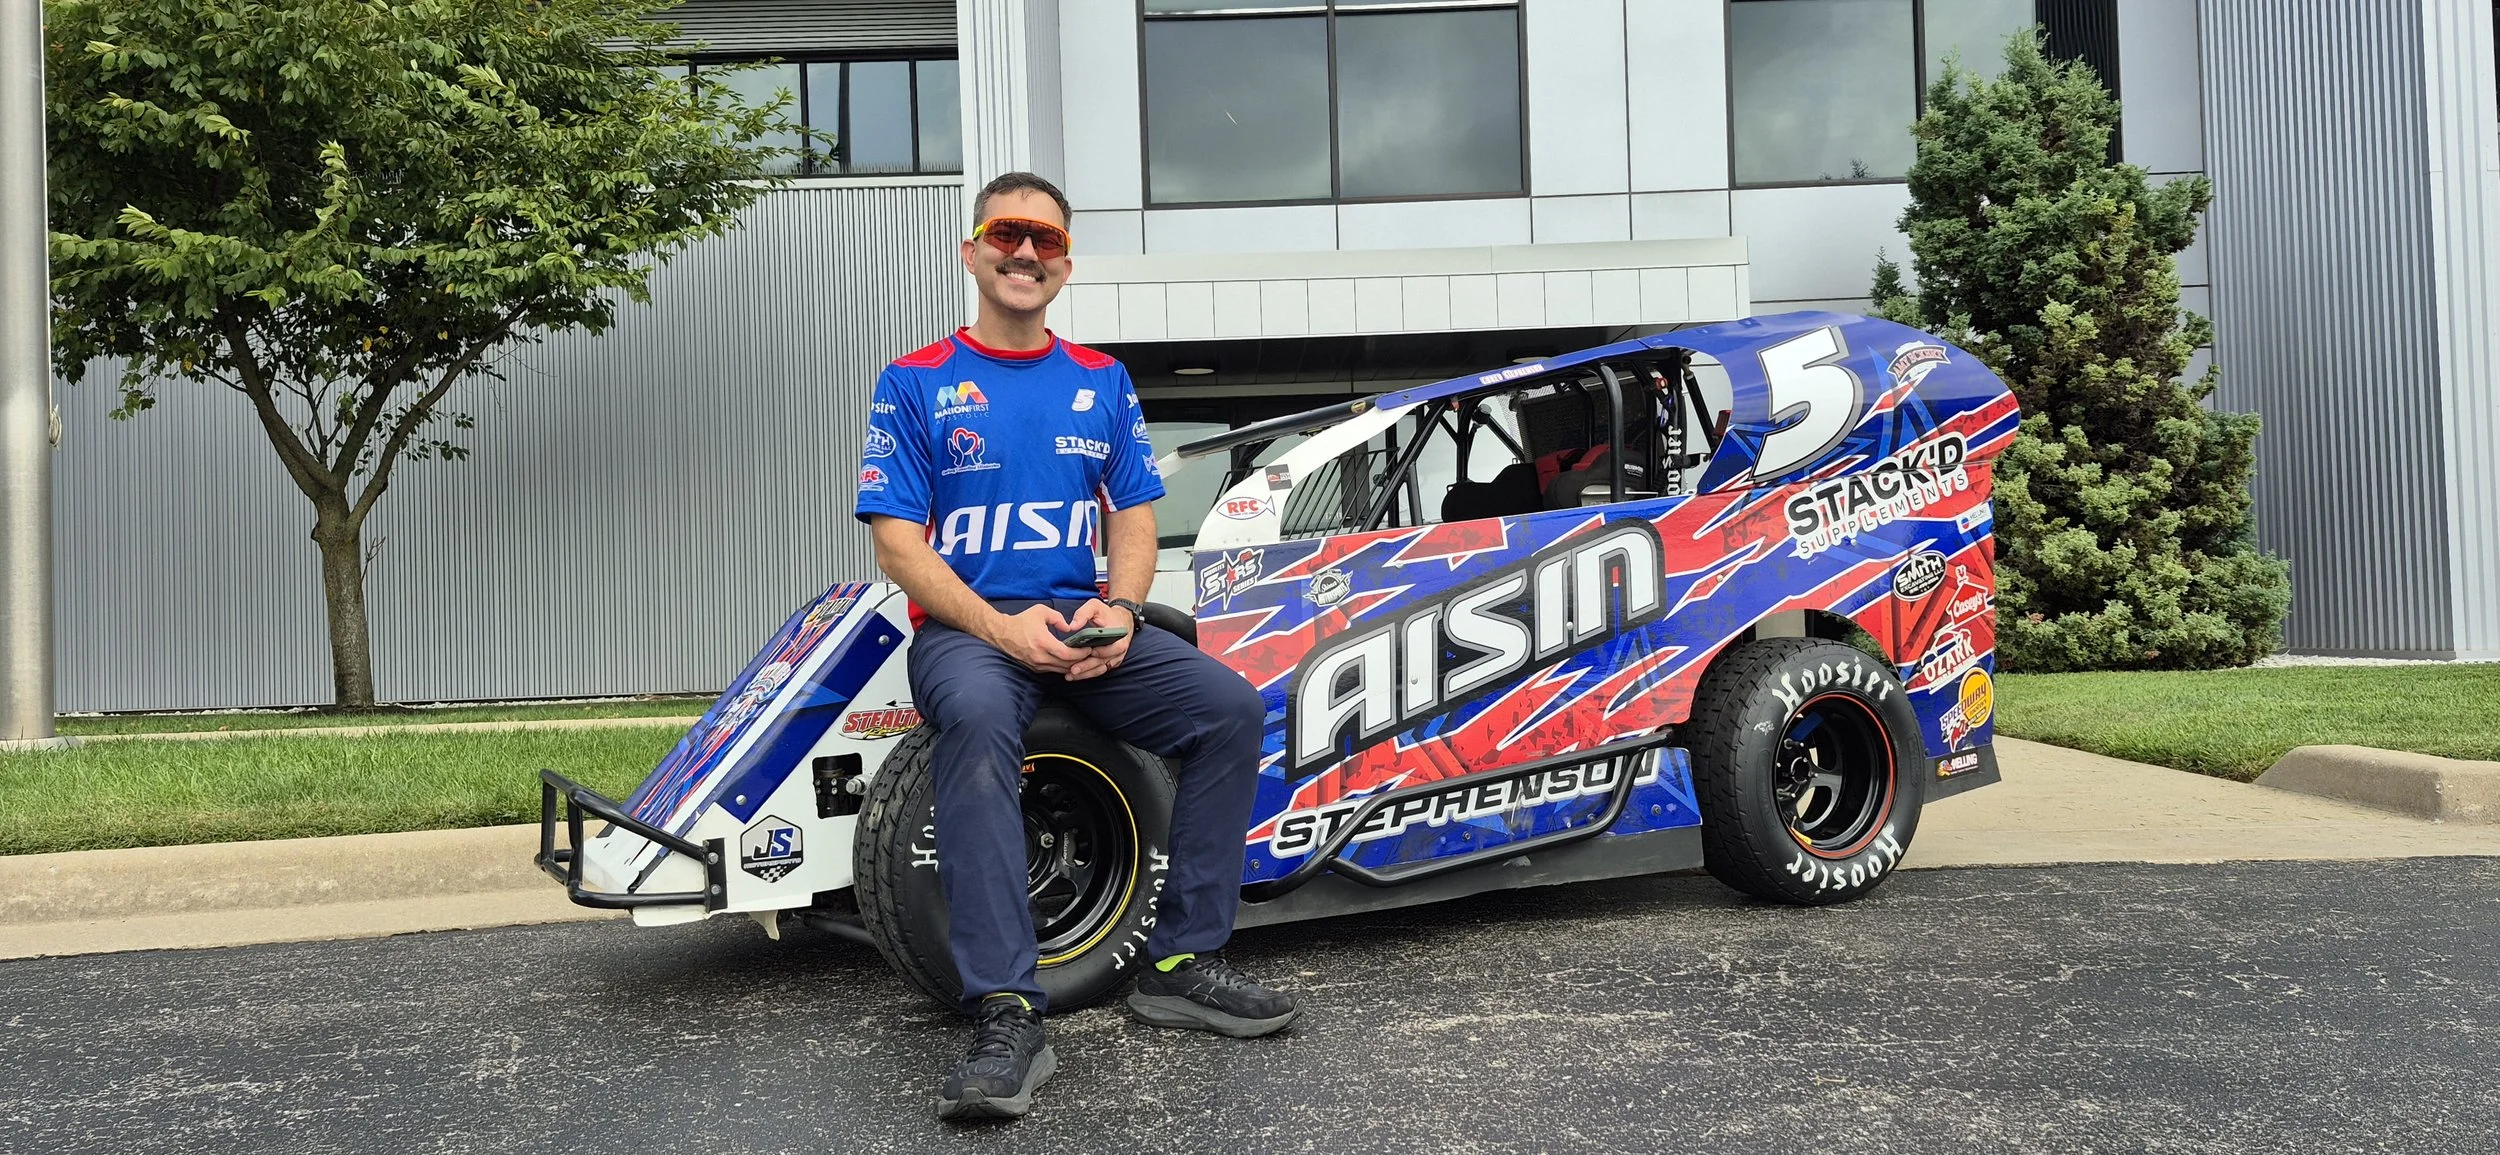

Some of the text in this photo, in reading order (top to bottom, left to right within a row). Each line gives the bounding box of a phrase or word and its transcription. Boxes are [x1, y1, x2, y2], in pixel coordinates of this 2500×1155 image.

[870, 397, 897, 415] sier
[1071, 388, 1096, 412] 5
[1751, 325, 1864, 483] 5
[1054, 435, 1111, 455] STACK'D
[1661, 425, 1682, 496] oosier
[1226, 500, 1259, 514] RFC
[1787, 437, 1966, 536] STACK'D
[938, 500, 1099, 556] AISIN
[1801, 473, 1966, 554] SUPPLEMENTS
[1897, 556, 1942, 588] SMITH
[1900, 572, 1934, 593] EXCAVATING
[1933, 566, 1945, 576] LLC
[1953, 591, 1983, 618] Casey's
[1297, 528, 1660, 768] AISIN
[1923, 634, 1976, 683] OZARK
[1772, 656, 1894, 724] Hoosier
[1941, 682, 1987, 731] SPEEDWAY
[1275, 750, 1657, 853] STEPHENSON
[752, 827, 794, 860] JS
[1787, 823, 1904, 894] Hoosier
